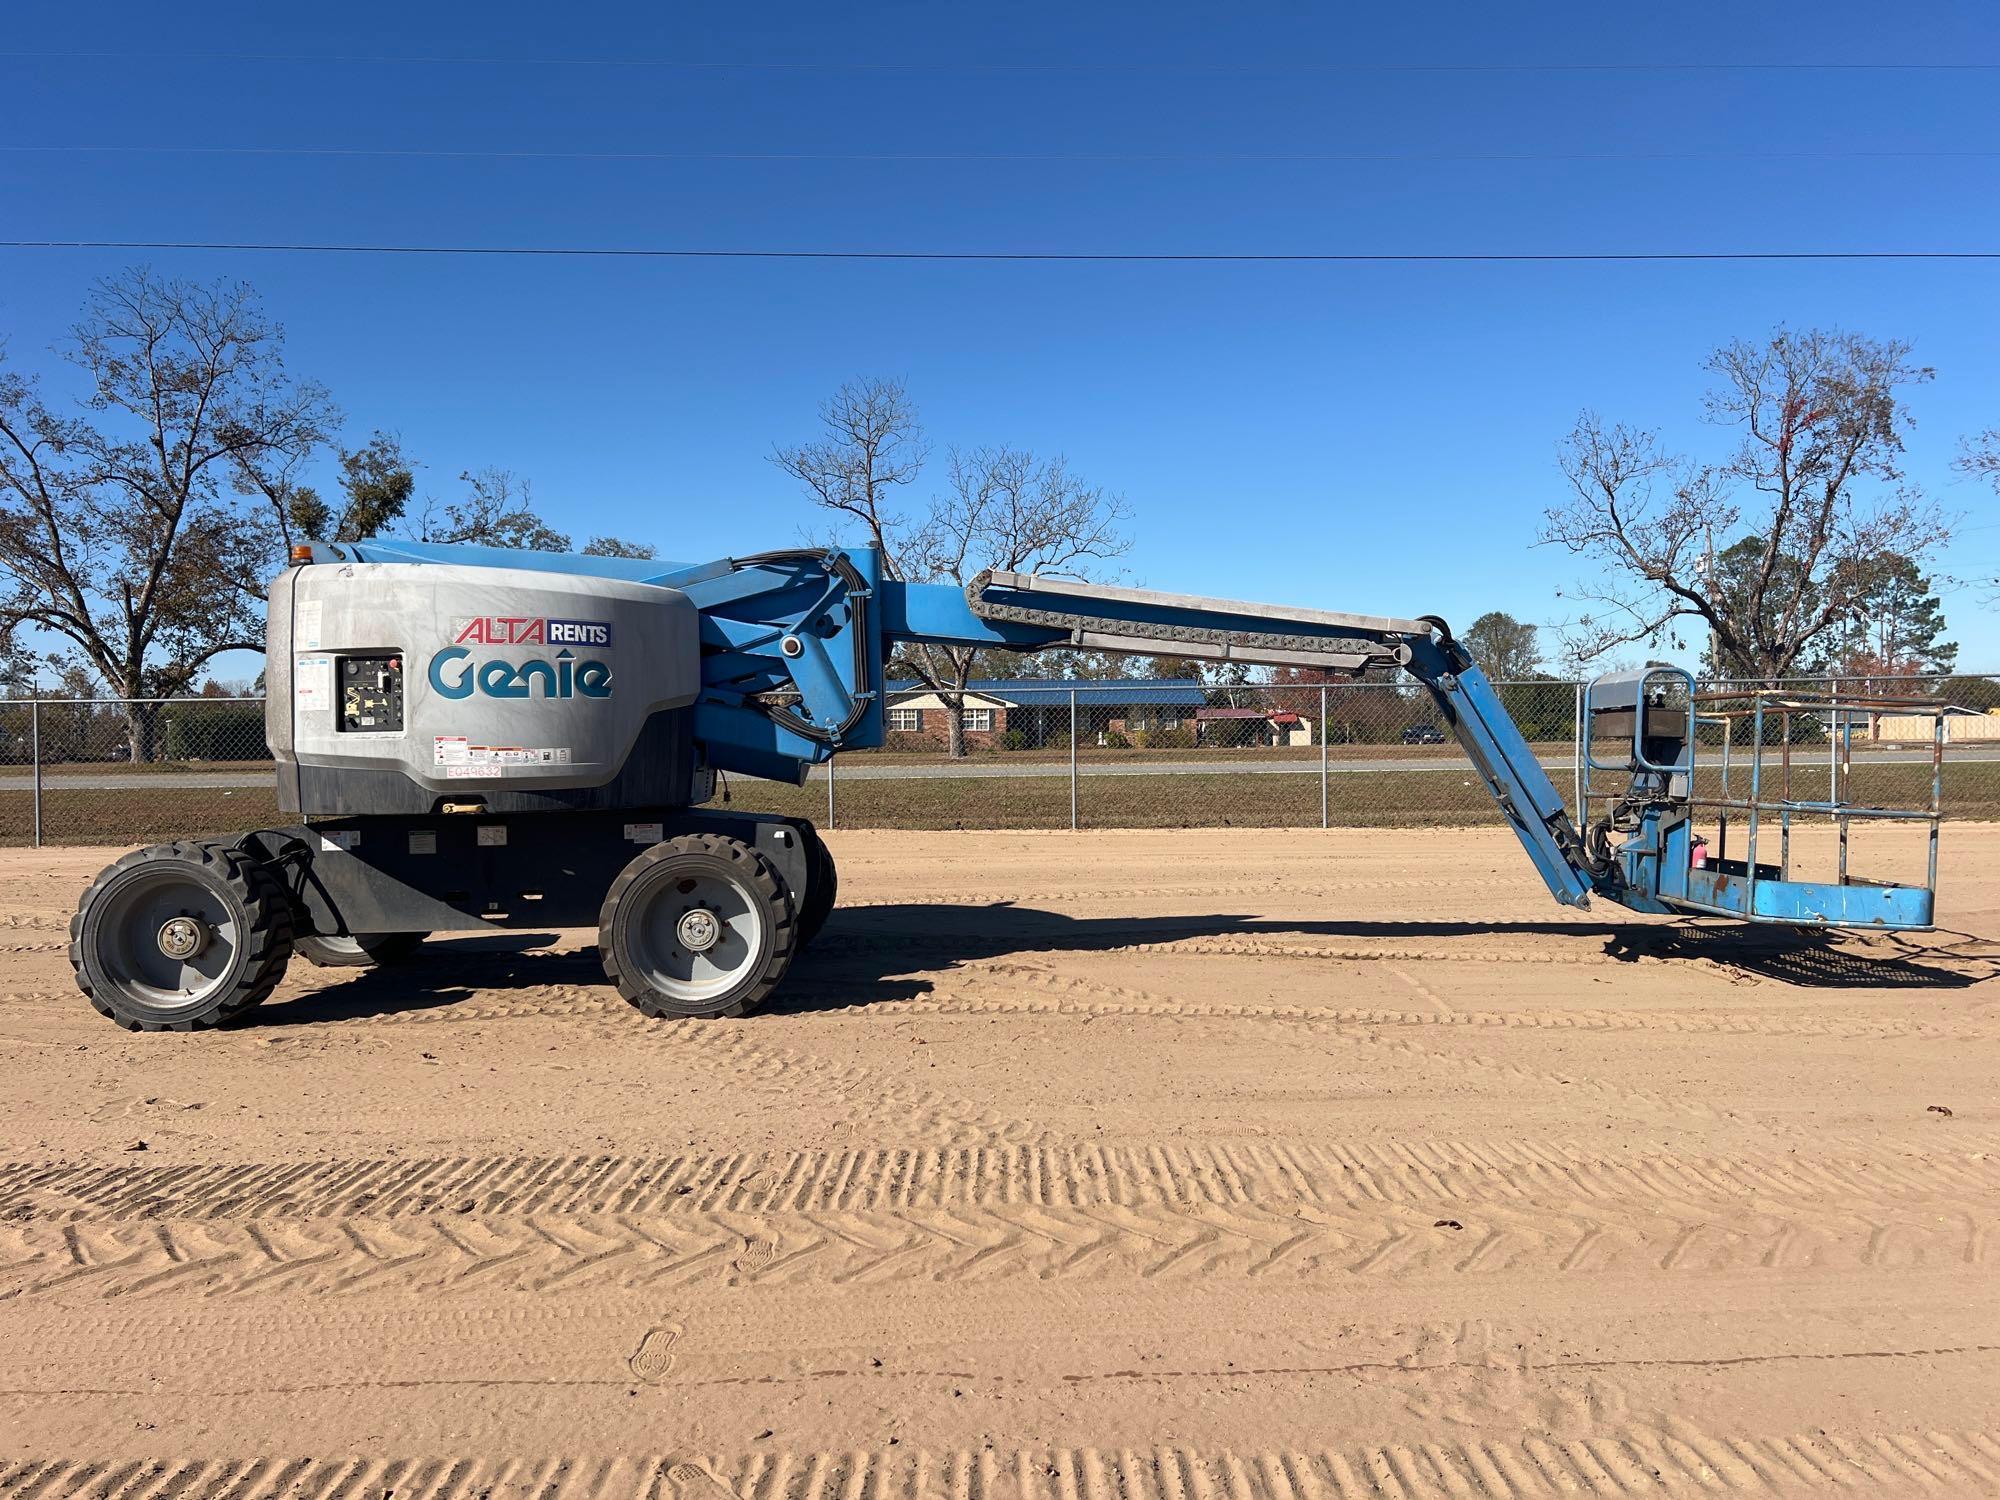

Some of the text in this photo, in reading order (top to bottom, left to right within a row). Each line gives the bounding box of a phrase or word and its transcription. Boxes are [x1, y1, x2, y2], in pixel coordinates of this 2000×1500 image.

[455, 618, 608, 645] ALTA RENTS
[428, 646, 613, 700] Genie
